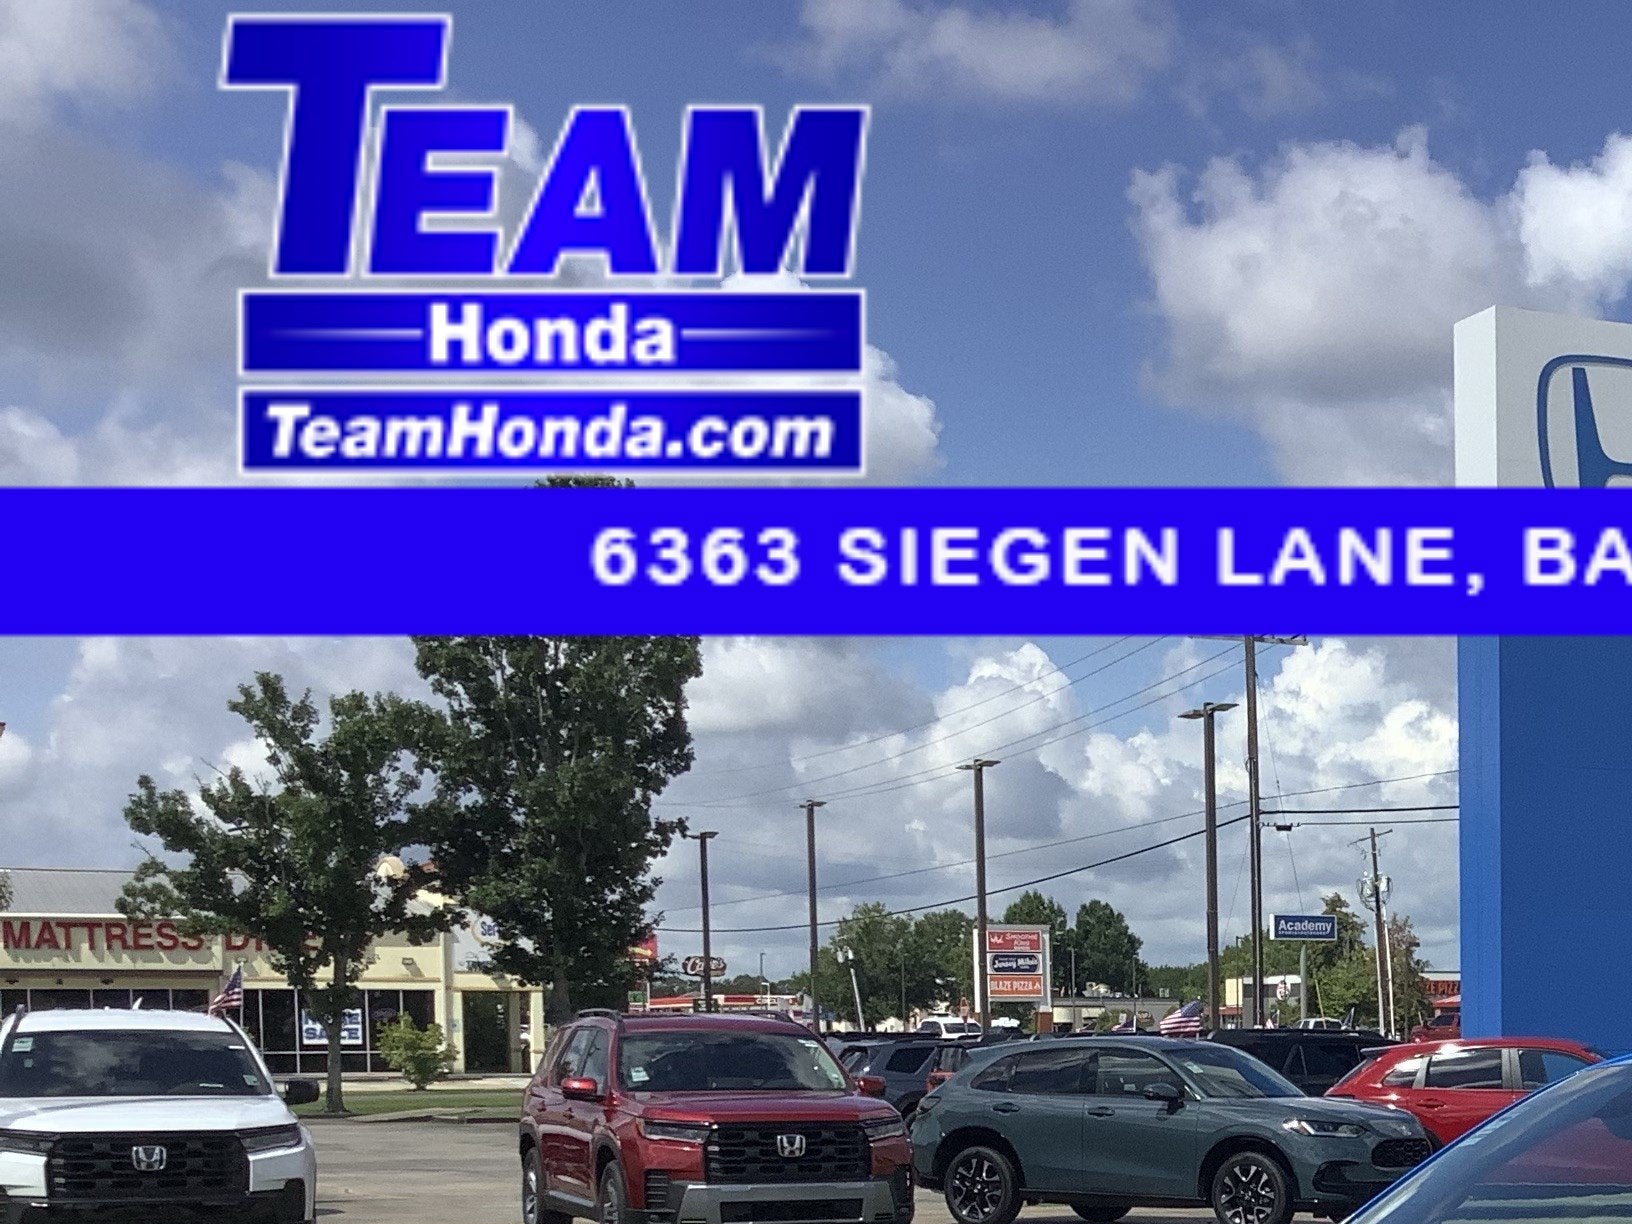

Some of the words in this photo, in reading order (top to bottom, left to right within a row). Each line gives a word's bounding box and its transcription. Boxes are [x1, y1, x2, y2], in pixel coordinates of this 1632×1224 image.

[1278, 920, 1332, 934] Academy
[990, 981, 1012, 991] BLAZE
[1013, 981, 1034, 991] PIZZA
